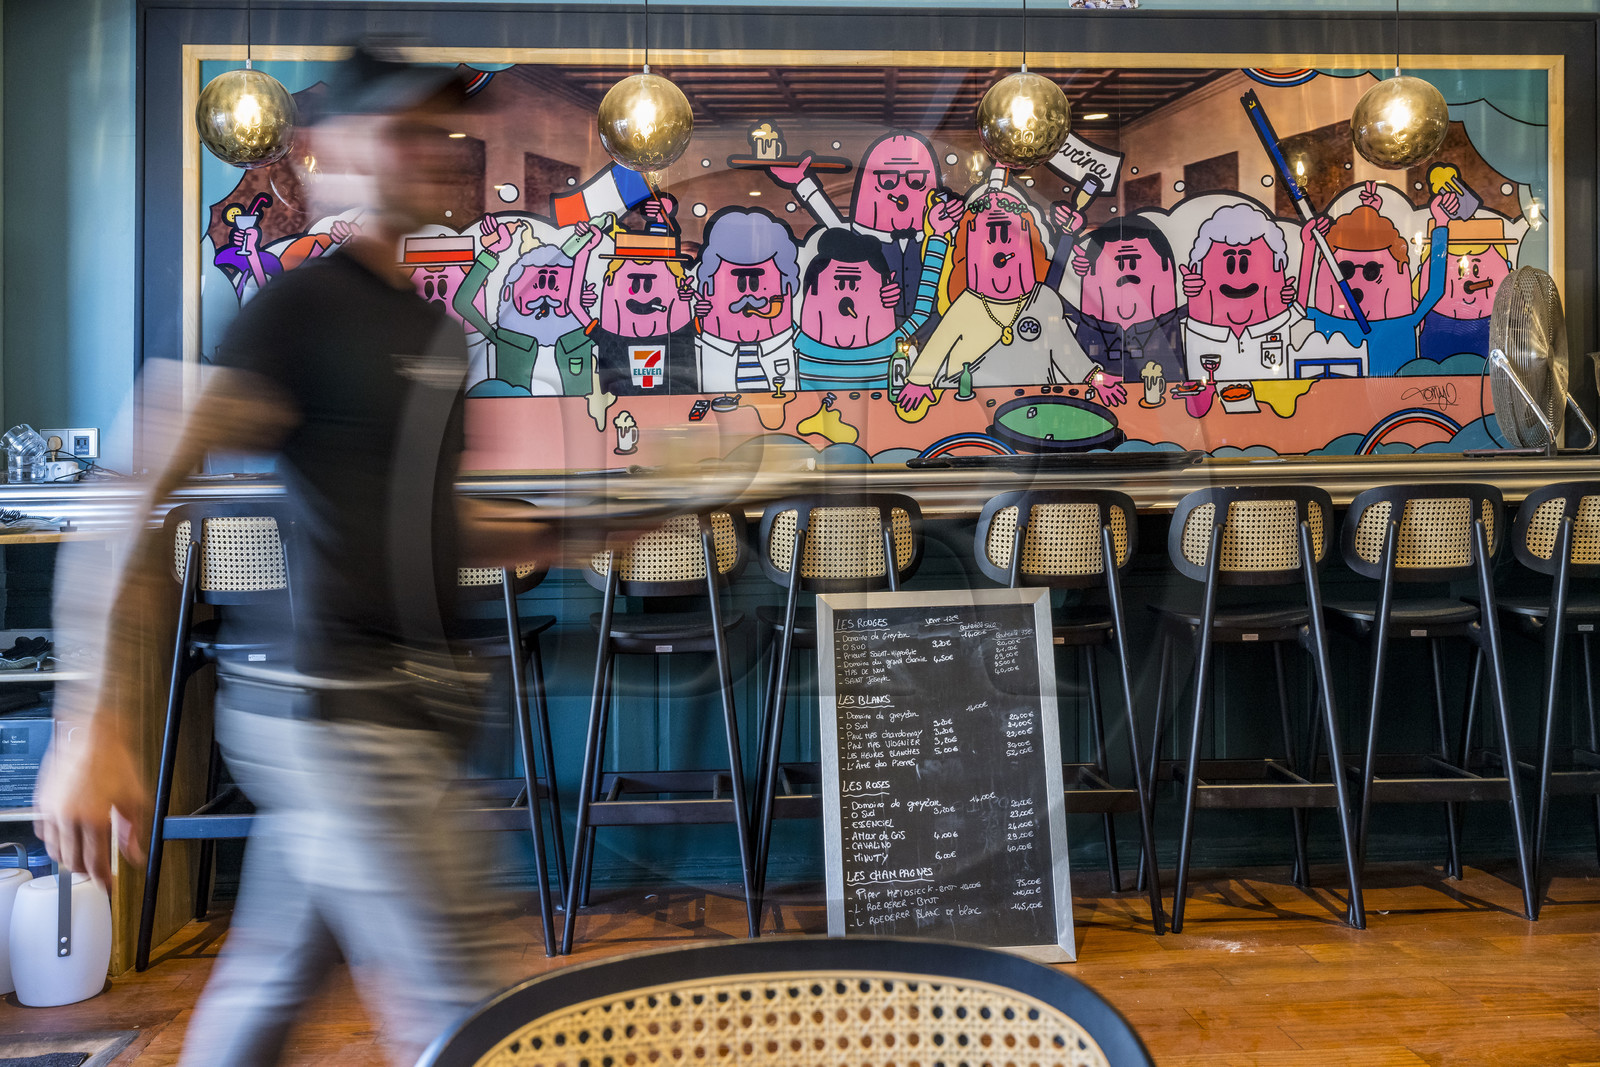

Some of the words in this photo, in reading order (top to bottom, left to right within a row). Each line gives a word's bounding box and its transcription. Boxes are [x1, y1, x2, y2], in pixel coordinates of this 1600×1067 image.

[836, 619, 854, 631] LES
[838, 694, 855, 705] LES
[842, 780, 862, 792] LES
[846, 871, 866, 882] LES
